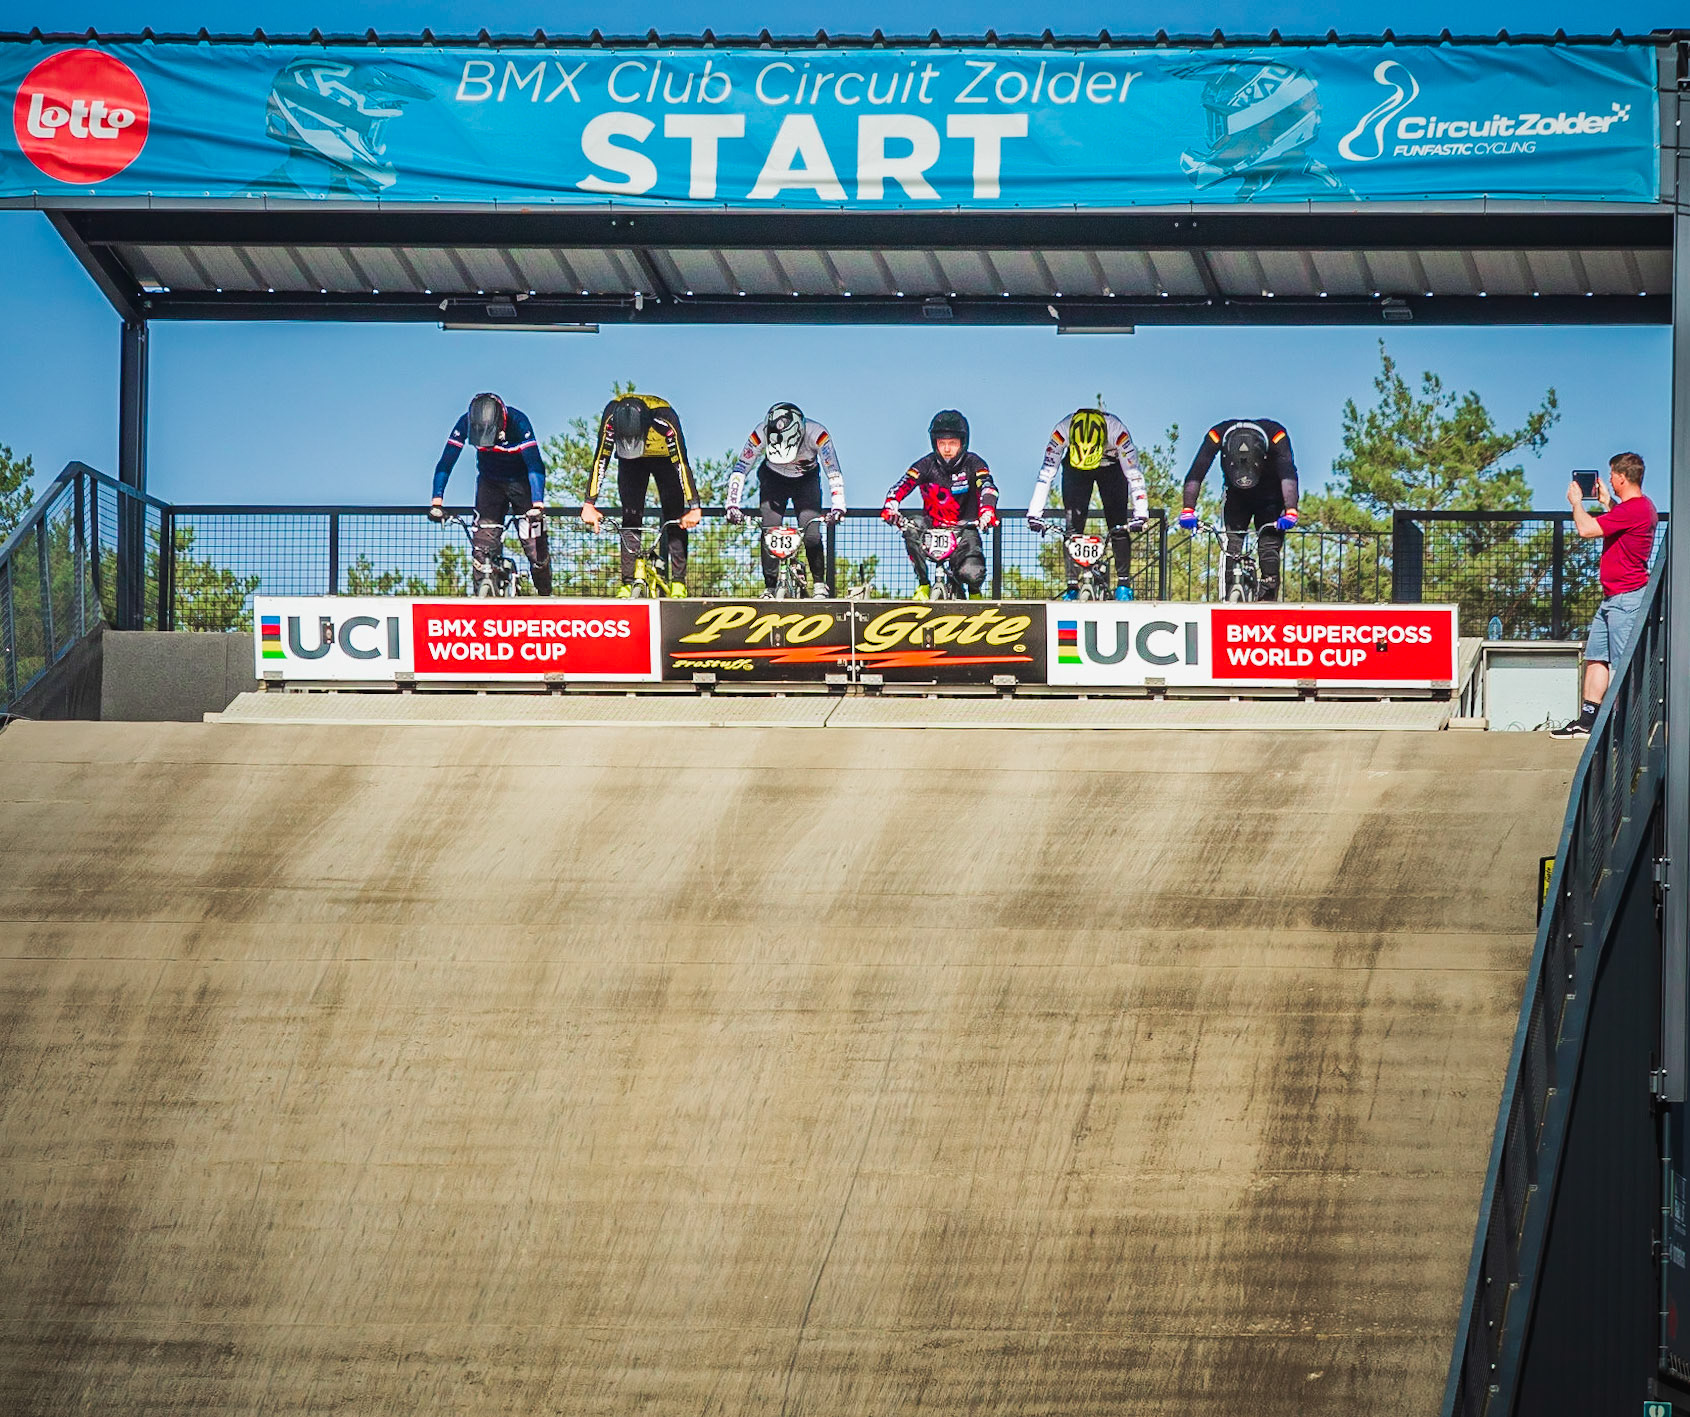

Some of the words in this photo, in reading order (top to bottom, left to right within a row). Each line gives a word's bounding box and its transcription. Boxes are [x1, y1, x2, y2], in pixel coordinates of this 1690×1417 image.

[456, 60, 588, 103] BMX
[607, 59, 732, 104] Club
[755, 60, 939, 105] Circuit
[955, 60, 1144, 104] Zolder
[27, 93, 135, 138] lotto
[575, 111, 1029, 200] START
[1393, 143, 1473, 157] FUNFASTIC
[1474, 141, 1536, 154] CYCLING
[771, 535, 792, 549] 813
[1074, 543, 1099, 558] 368
[287, 616, 400, 660] UCI
[428, 619, 477, 637] BMX
[483, 619, 631, 638] SUPERCROSS
[678, 606, 834, 644] Pro
[856, 606, 1032, 652] Gate
[1226, 625, 1276, 643] BMX
[1282, 626, 1432, 644] SUPERCROSS
[428, 642, 514, 661] WORLD
[520, 642, 567, 661] CUP
[1084, 621, 1198, 665] UCI
[1227, 648, 1313, 666] WORLD
[1321, 648, 1367, 667] CUP
